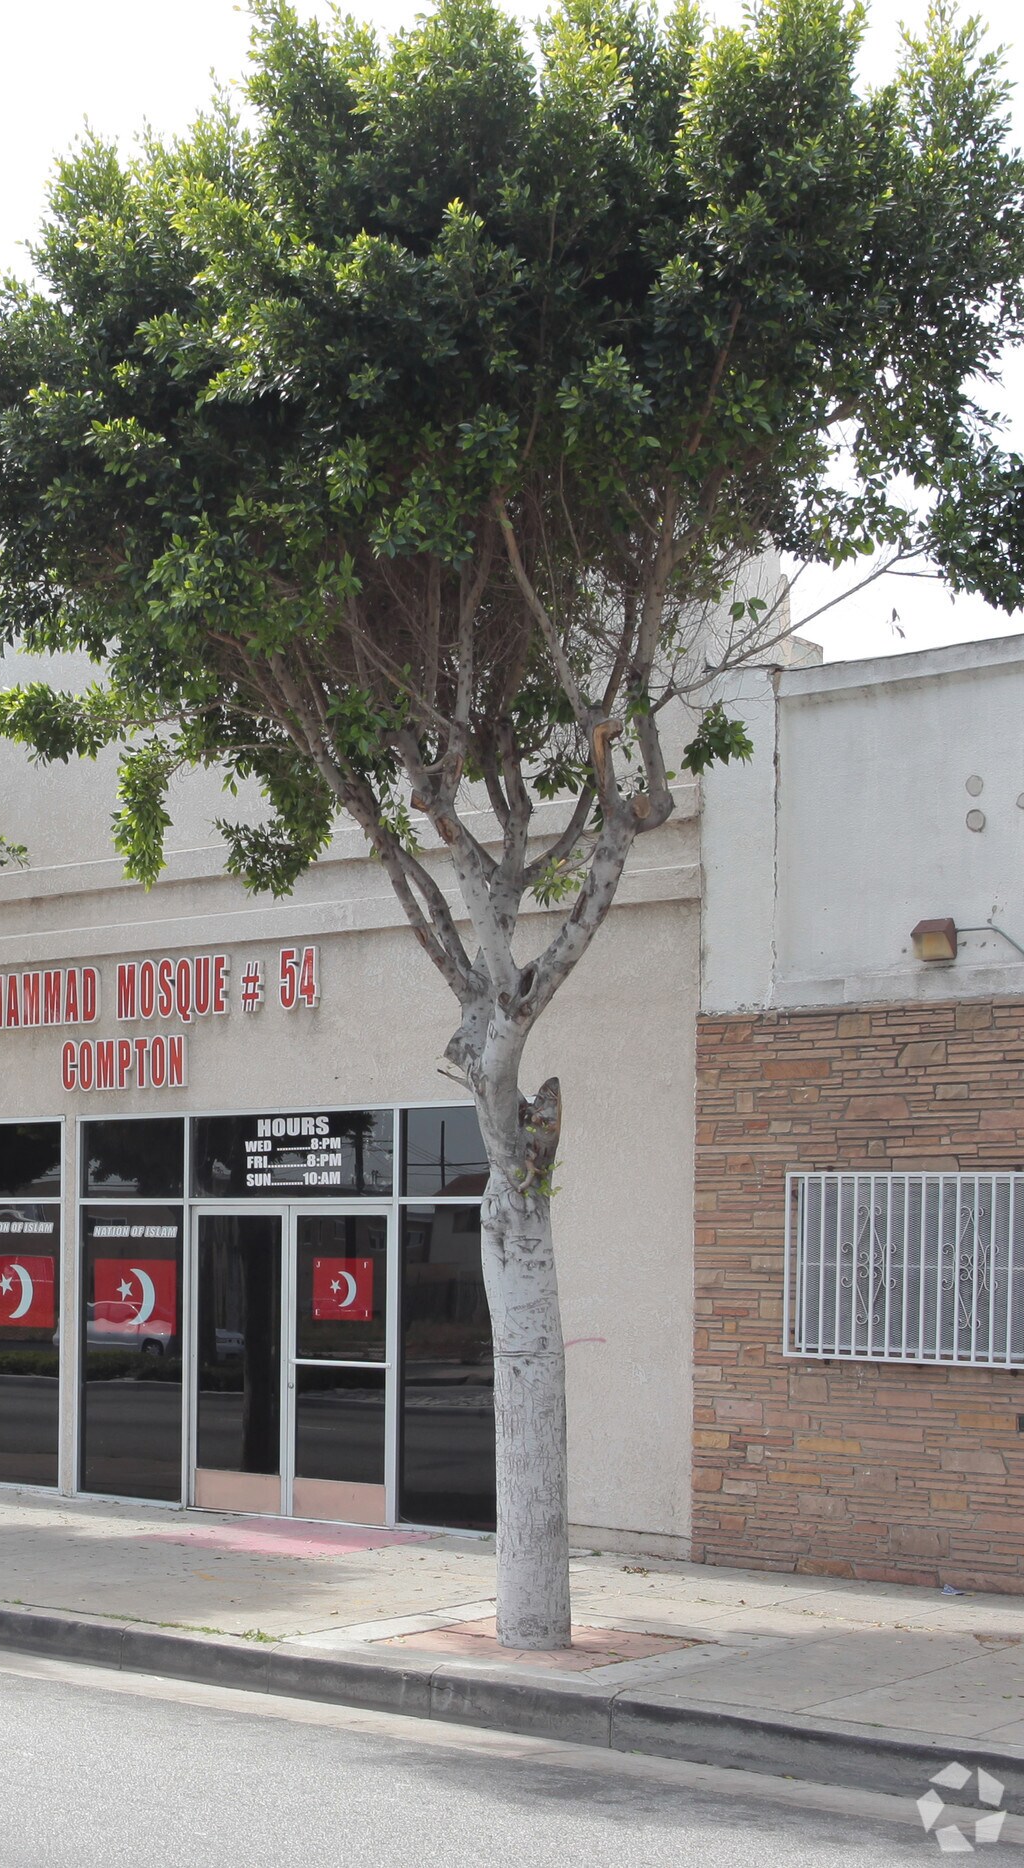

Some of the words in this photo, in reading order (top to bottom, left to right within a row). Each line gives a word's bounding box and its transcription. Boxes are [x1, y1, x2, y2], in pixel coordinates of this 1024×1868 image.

[117, 954, 229, 1023] MOSQUE
[242, 961, 264, 1012] #
[279, 946, 320, 1009] 54
[62, 1035, 188, 1091] COMPTON
[257, 1116, 330, 1137] HOURS
[245, 1140, 272, 1153] WED
[10, 1222, 23, 1233] OF
[23, 1222, 54, 1233] ISLAM
[93, 1226, 129, 1237] NATION
[130, 1226, 144, 1237] OF
[144, 1226, 178, 1237] ISLAM
